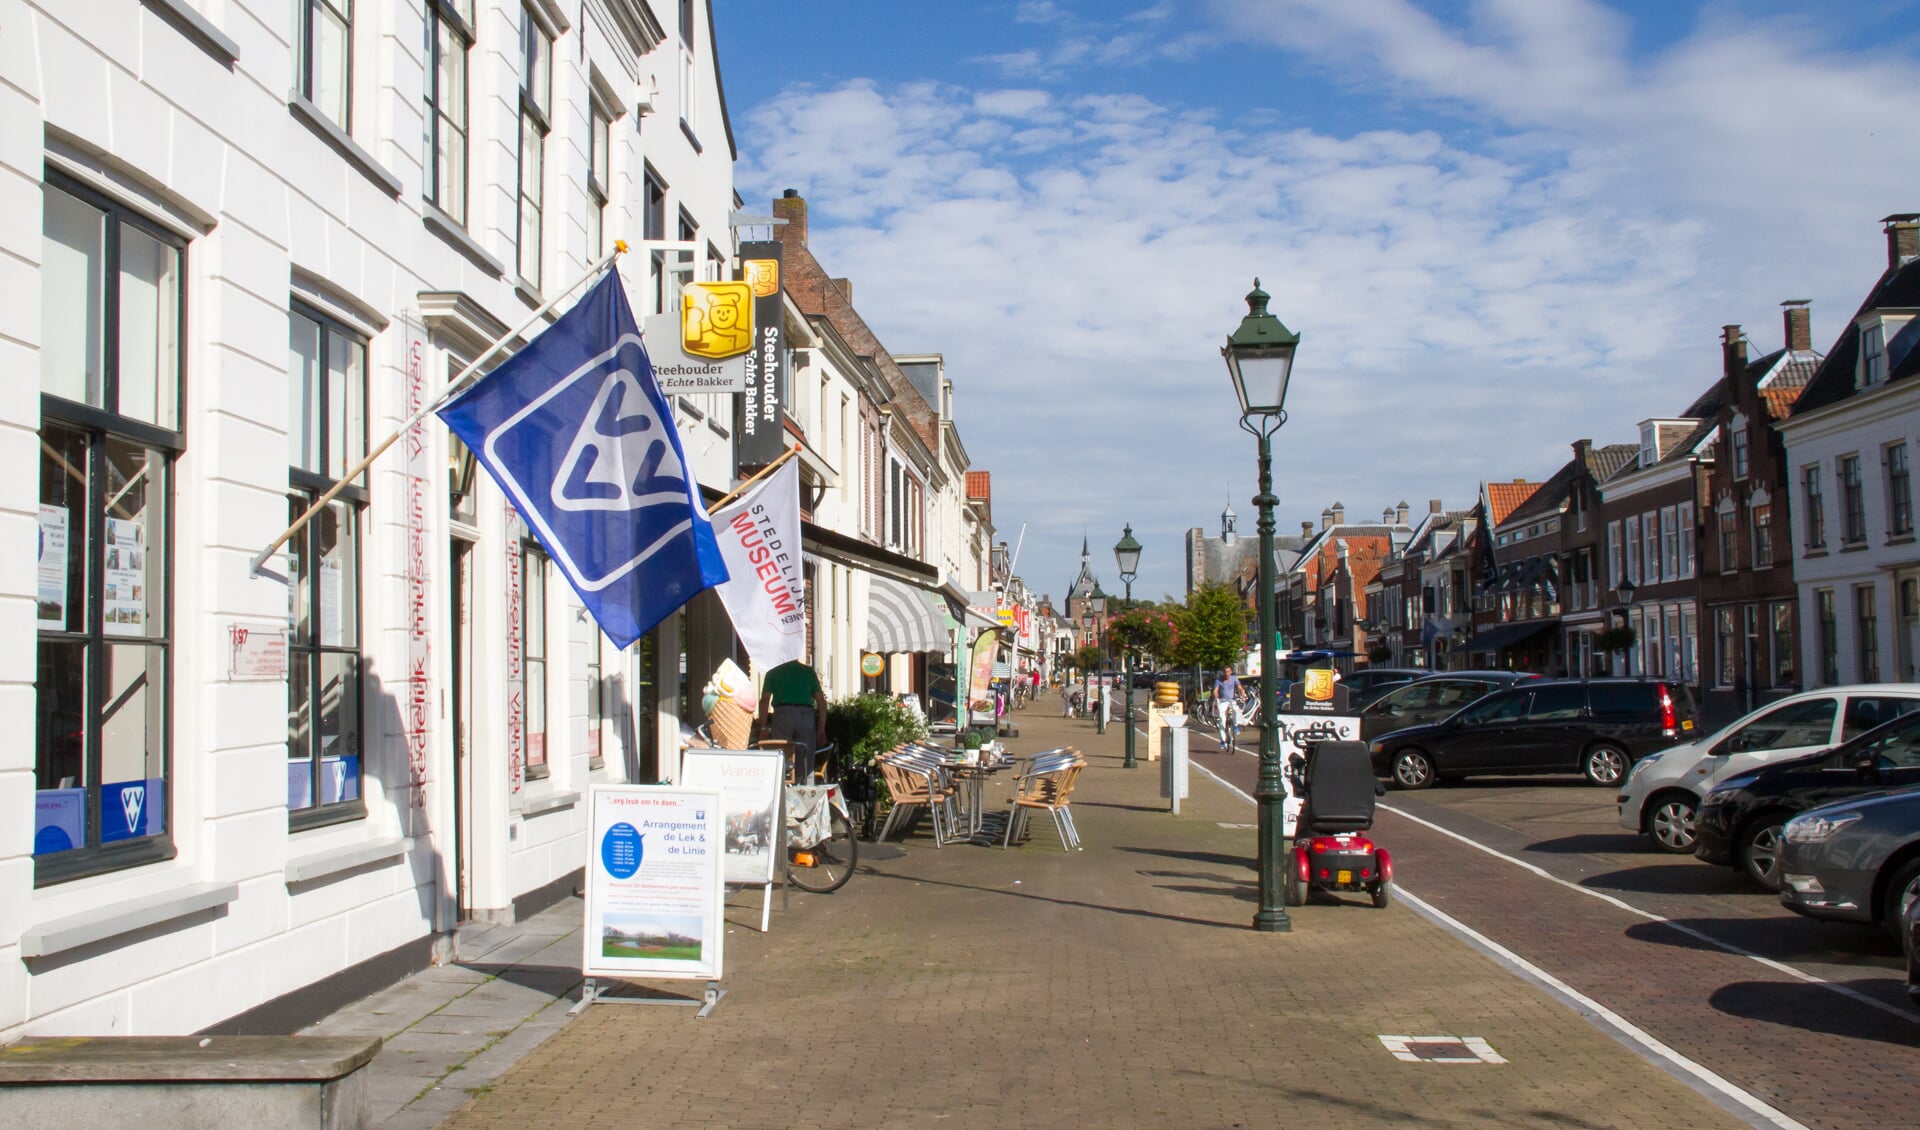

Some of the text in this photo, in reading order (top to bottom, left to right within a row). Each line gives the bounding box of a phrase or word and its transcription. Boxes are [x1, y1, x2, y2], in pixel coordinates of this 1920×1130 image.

[412, 340, 422, 456] Vianen
[650, 364, 724, 376] Steehouder
[667, 378, 695, 388] Echte
[696, 377, 734, 387] Bakker
[745, 349, 758, 435] Echte Bakker
[764, 327, 779, 422] Steehouder
[415, 477, 424, 636] museum
[730, 511, 795, 615] MUSEUM
[752, 504, 806, 608] STEDELIJK
[511, 541, 520, 678] museum
[415, 657, 427, 808] stedelijk
[512, 691, 521, 793] Vianen
[720, 763, 765, 777] Vianen
[1281, 720, 1350, 741] Koffe
[643, 820, 706, 831] Arrangement
[664, 833, 706, 842] de Lek &
[668, 846, 706, 856] de Linie
